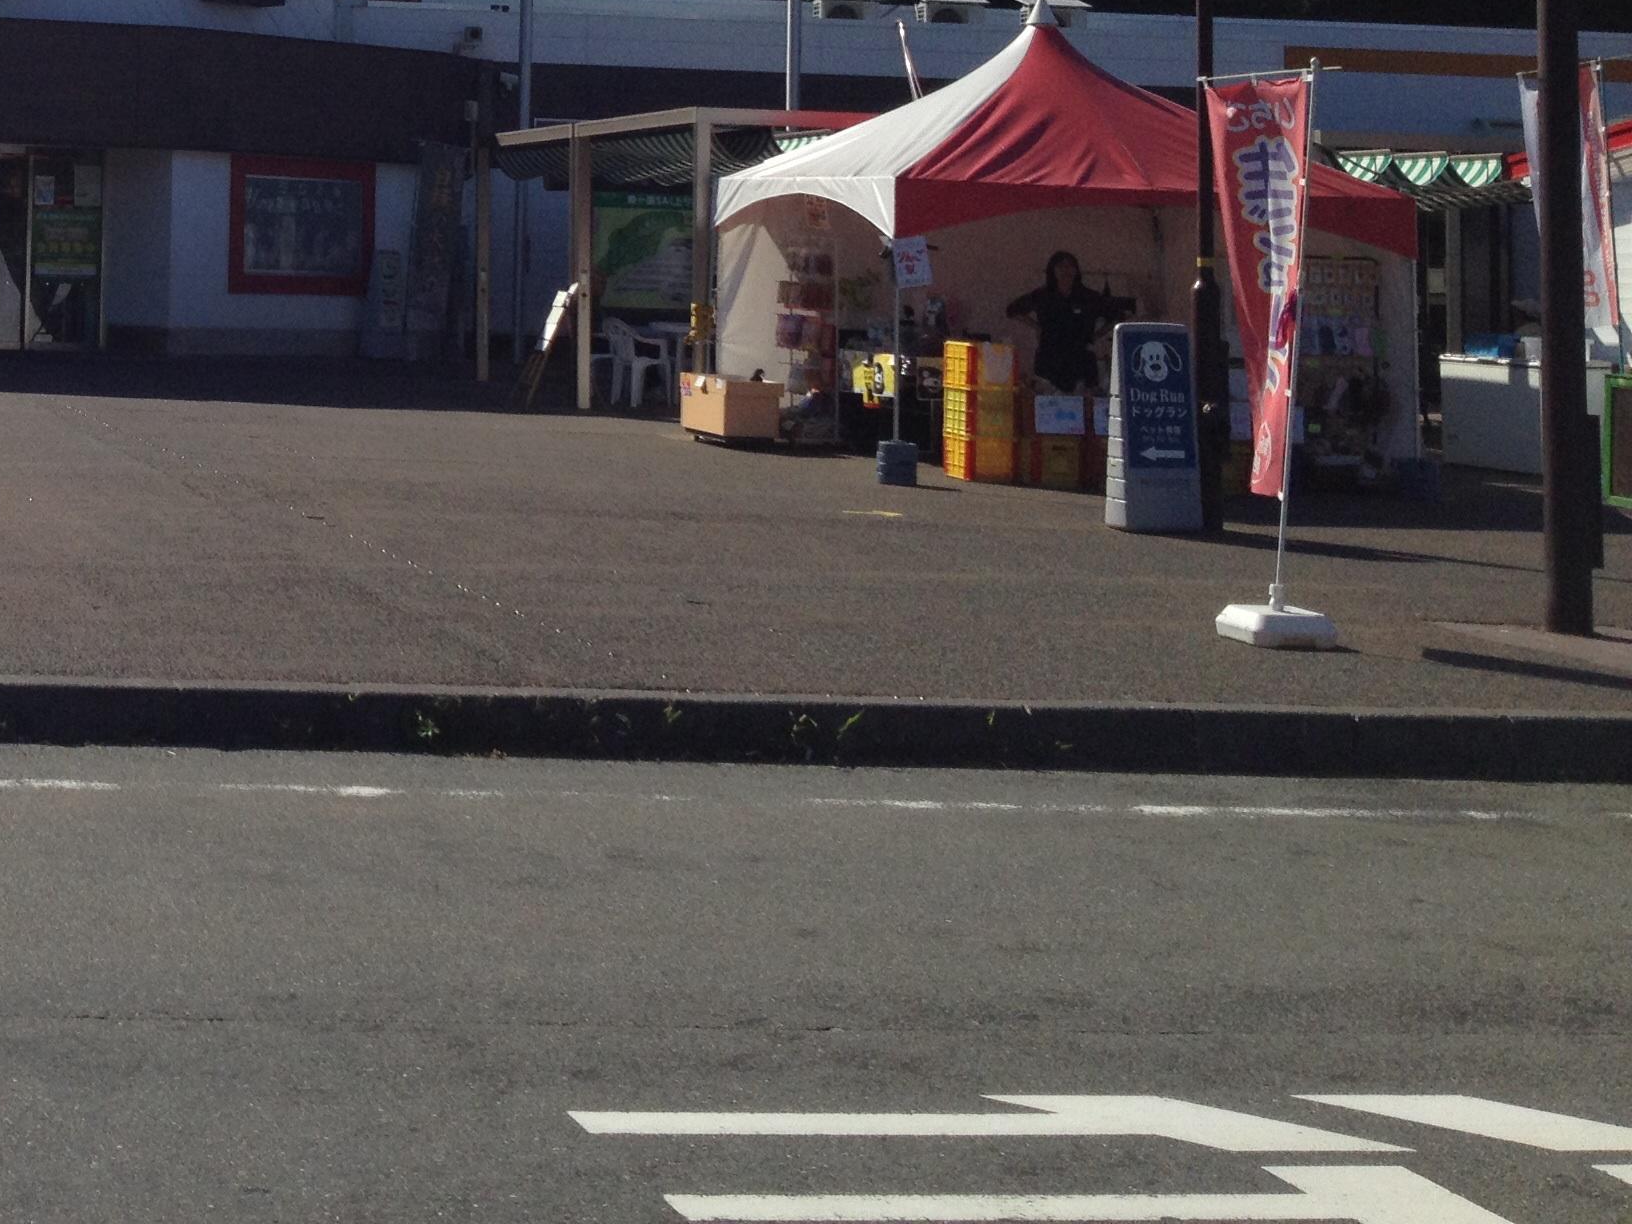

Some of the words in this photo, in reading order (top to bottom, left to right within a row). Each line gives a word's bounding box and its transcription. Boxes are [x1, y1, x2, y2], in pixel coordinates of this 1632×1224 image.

[1130, 387, 1158, 404] Dog
[1160, 388, 1185, 403] Run
[1132, 406, 1187, 417] ドッグラン
